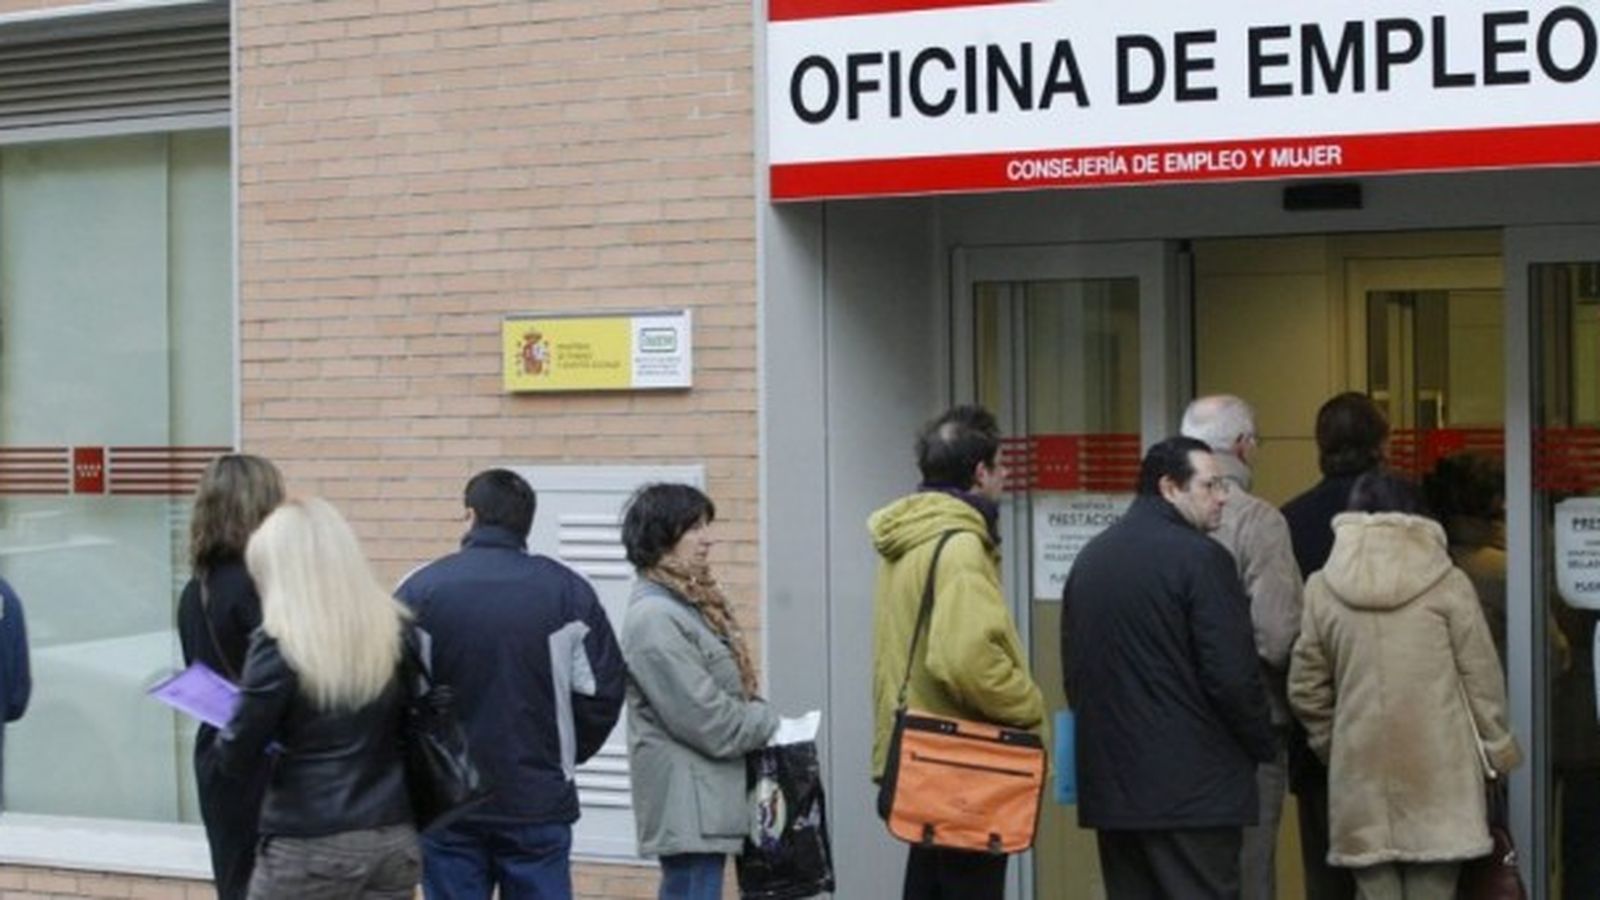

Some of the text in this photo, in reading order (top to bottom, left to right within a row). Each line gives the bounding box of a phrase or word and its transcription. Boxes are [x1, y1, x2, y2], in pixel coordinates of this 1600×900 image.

[790, 5, 1598, 125] OFICINA DE EMPLEO
[1007, 144, 1342, 180] CONSEJERÍA DE EMPLEO Y MUJER
